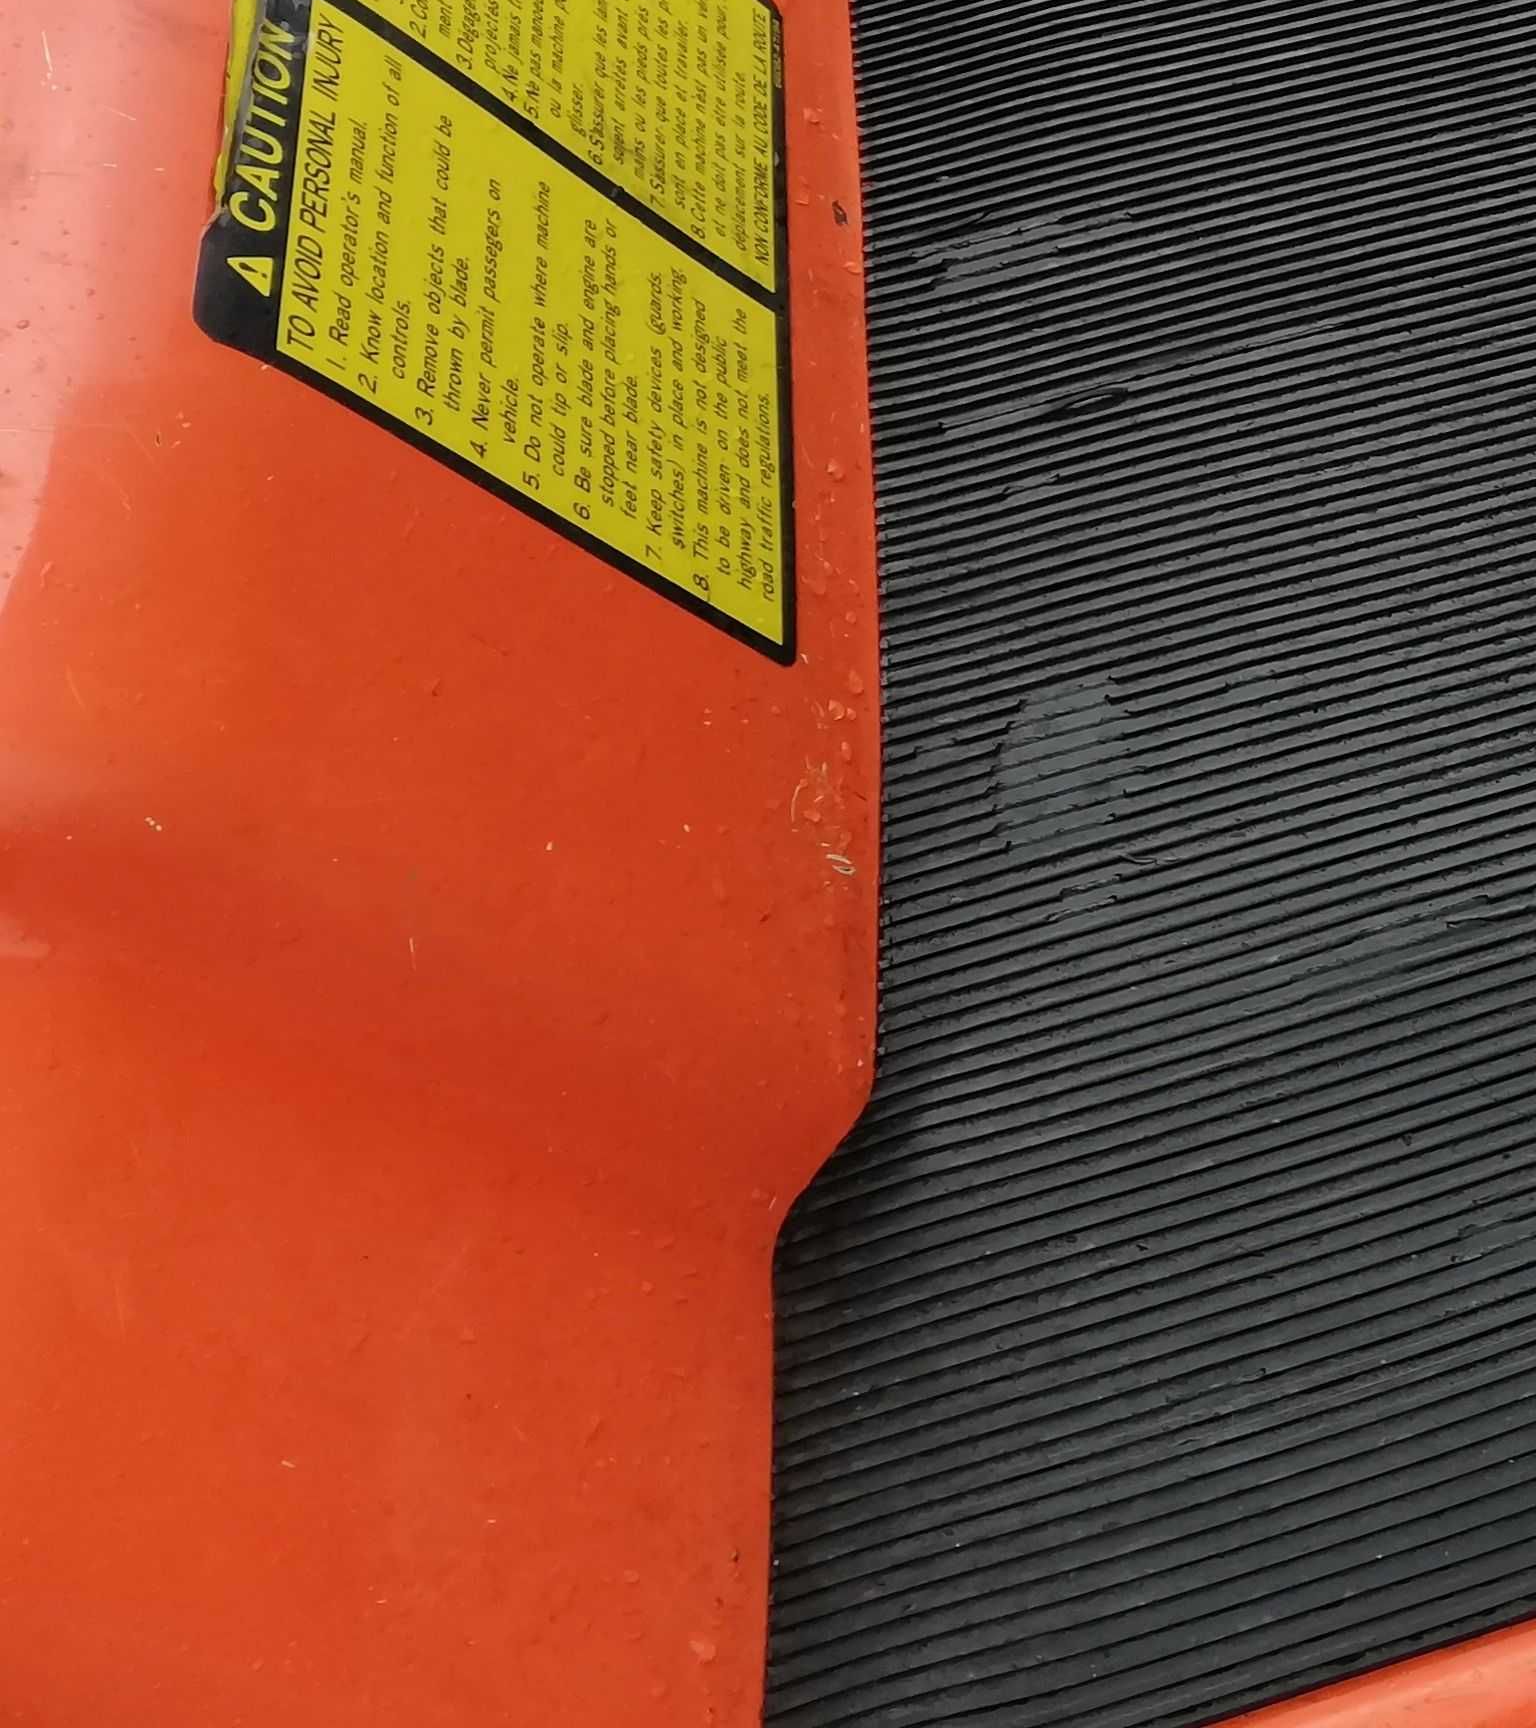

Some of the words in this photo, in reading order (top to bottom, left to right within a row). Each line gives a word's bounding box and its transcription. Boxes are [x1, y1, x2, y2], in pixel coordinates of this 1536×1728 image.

[751, 7, 766, 52] ROUTE
[312, 14, 343, 101] INJURY
[383, 54, 402, 81] all
[752, 53, 766, 75] LA
[381, 81, 400, 106] of
[752, 73, 767, 96] DE
[229, 22, 297, 234] CAUTION
[434, 114, 452, 138] be
[752, 95, 768, 134] CODE
[348, 118, 366, 184] manual.
[375, 112, 398, 183] function
[433, 139, 450, 190] could
[752, 134, 768, 156] AU
[299, 111, 335, 232] PERSONAL
[488, 178, 501, 201] on
[374, 185, 392, 224] and
[427, 196, 447, 235] that
[533, 181, 550, 249] machine
[752, 157, 768, 232] CONFORME
[340, 191, 360, 286] operator's
[583, 218, 597, 248] are
[605, 217, 617, 238] or
[754, 233, 768, 265] NON
[291, 234, 323, 311] AVOID
[365, 230, 388, 304] location
[483, 208, 503, 302] passegers
[600, 244, 616, 295] hands
[423, 243, 446, 314] objects
[449, 257, 469, 307] blade.
[530, 255, 547, 307] where
[582, 255, 599, 310] engine
[286, 314, 315, 350] TO
[328, 291, 351, 346] Read
[359, 309, 381, 364] Know
[391, 300, 410, 379] controls.
[447, 314, 470, 339] by
[477, 305, 496, 368] permit
[578, 314, 594, 351] and
[600, 298, 621, 365] placing
[691, 297, 709, 373] designed
[731, 307, 747, 335] the
[416, 323, 439, 397] Remove
[530, 316, 547, 386] operate
[555, 361, 567, 384] or
[669, 336, 683, 372] and
[712, 335, 731, 388] public
[733, 341, 748, 382] meet
[357, 372, 377, 394] 2.
[442, 347, 462, 411] thrown
[471, 372, 491, 430] Never
[576, 358, 593, 407] blade
[599, 368, 616, 426] before
[621, 375, 638, 424] blade.
[647, 346, 662, 413] devices
[692, 379, 707, 411] not
[414, 406, 434, 426] 3.
[499, 378, 518, 443] vehicle.
[527, 393, 543, 427] not
[550, 391, 571, 416] tip
[668, 378, 687, 429] place
[713, 391, 728, 420] the
[733, 389, 748, 419] not
[579, 415, 592, 457] sure
[672, 433, 683, 451] in
[695, 417, 707, 435] is
[716, 428, 728, 451] on
[735, 425, 750, 468] does
[755, 393, 773, 487] regulations.
[469, 439, 488, 458] 4.
[523, 435, 541, 462] Do
[549, 422, 566, 476] could
[599, 429, 618, 507] stopped
[625, 430, 637, 473] near
[646, 420, 665, 480] safety
[521, 471, 540, 490] 5.
[573, 466, 591, 493] Be
[619, 480, 637, 519] feet
[692, 442, 708, 514] machine
[716, 463, 731, 515] driven
[735, 473, 751, 509] and
[572, 501, 590, 520] 6.
[645, 488, 665, 536] Keep
[667, 459, 685, 549] switches)
[756, 496, 773, 551] traffic
[644, 543, 662, 560] 7.
[692, 522, 709, 560] This
[714, 525, 730, 548] be
[736, 518, 756, 590] highway
[692, 573, 710, 591] 8.
[715, 556, 731, 575] to
[758, 558, 774, 602] road
